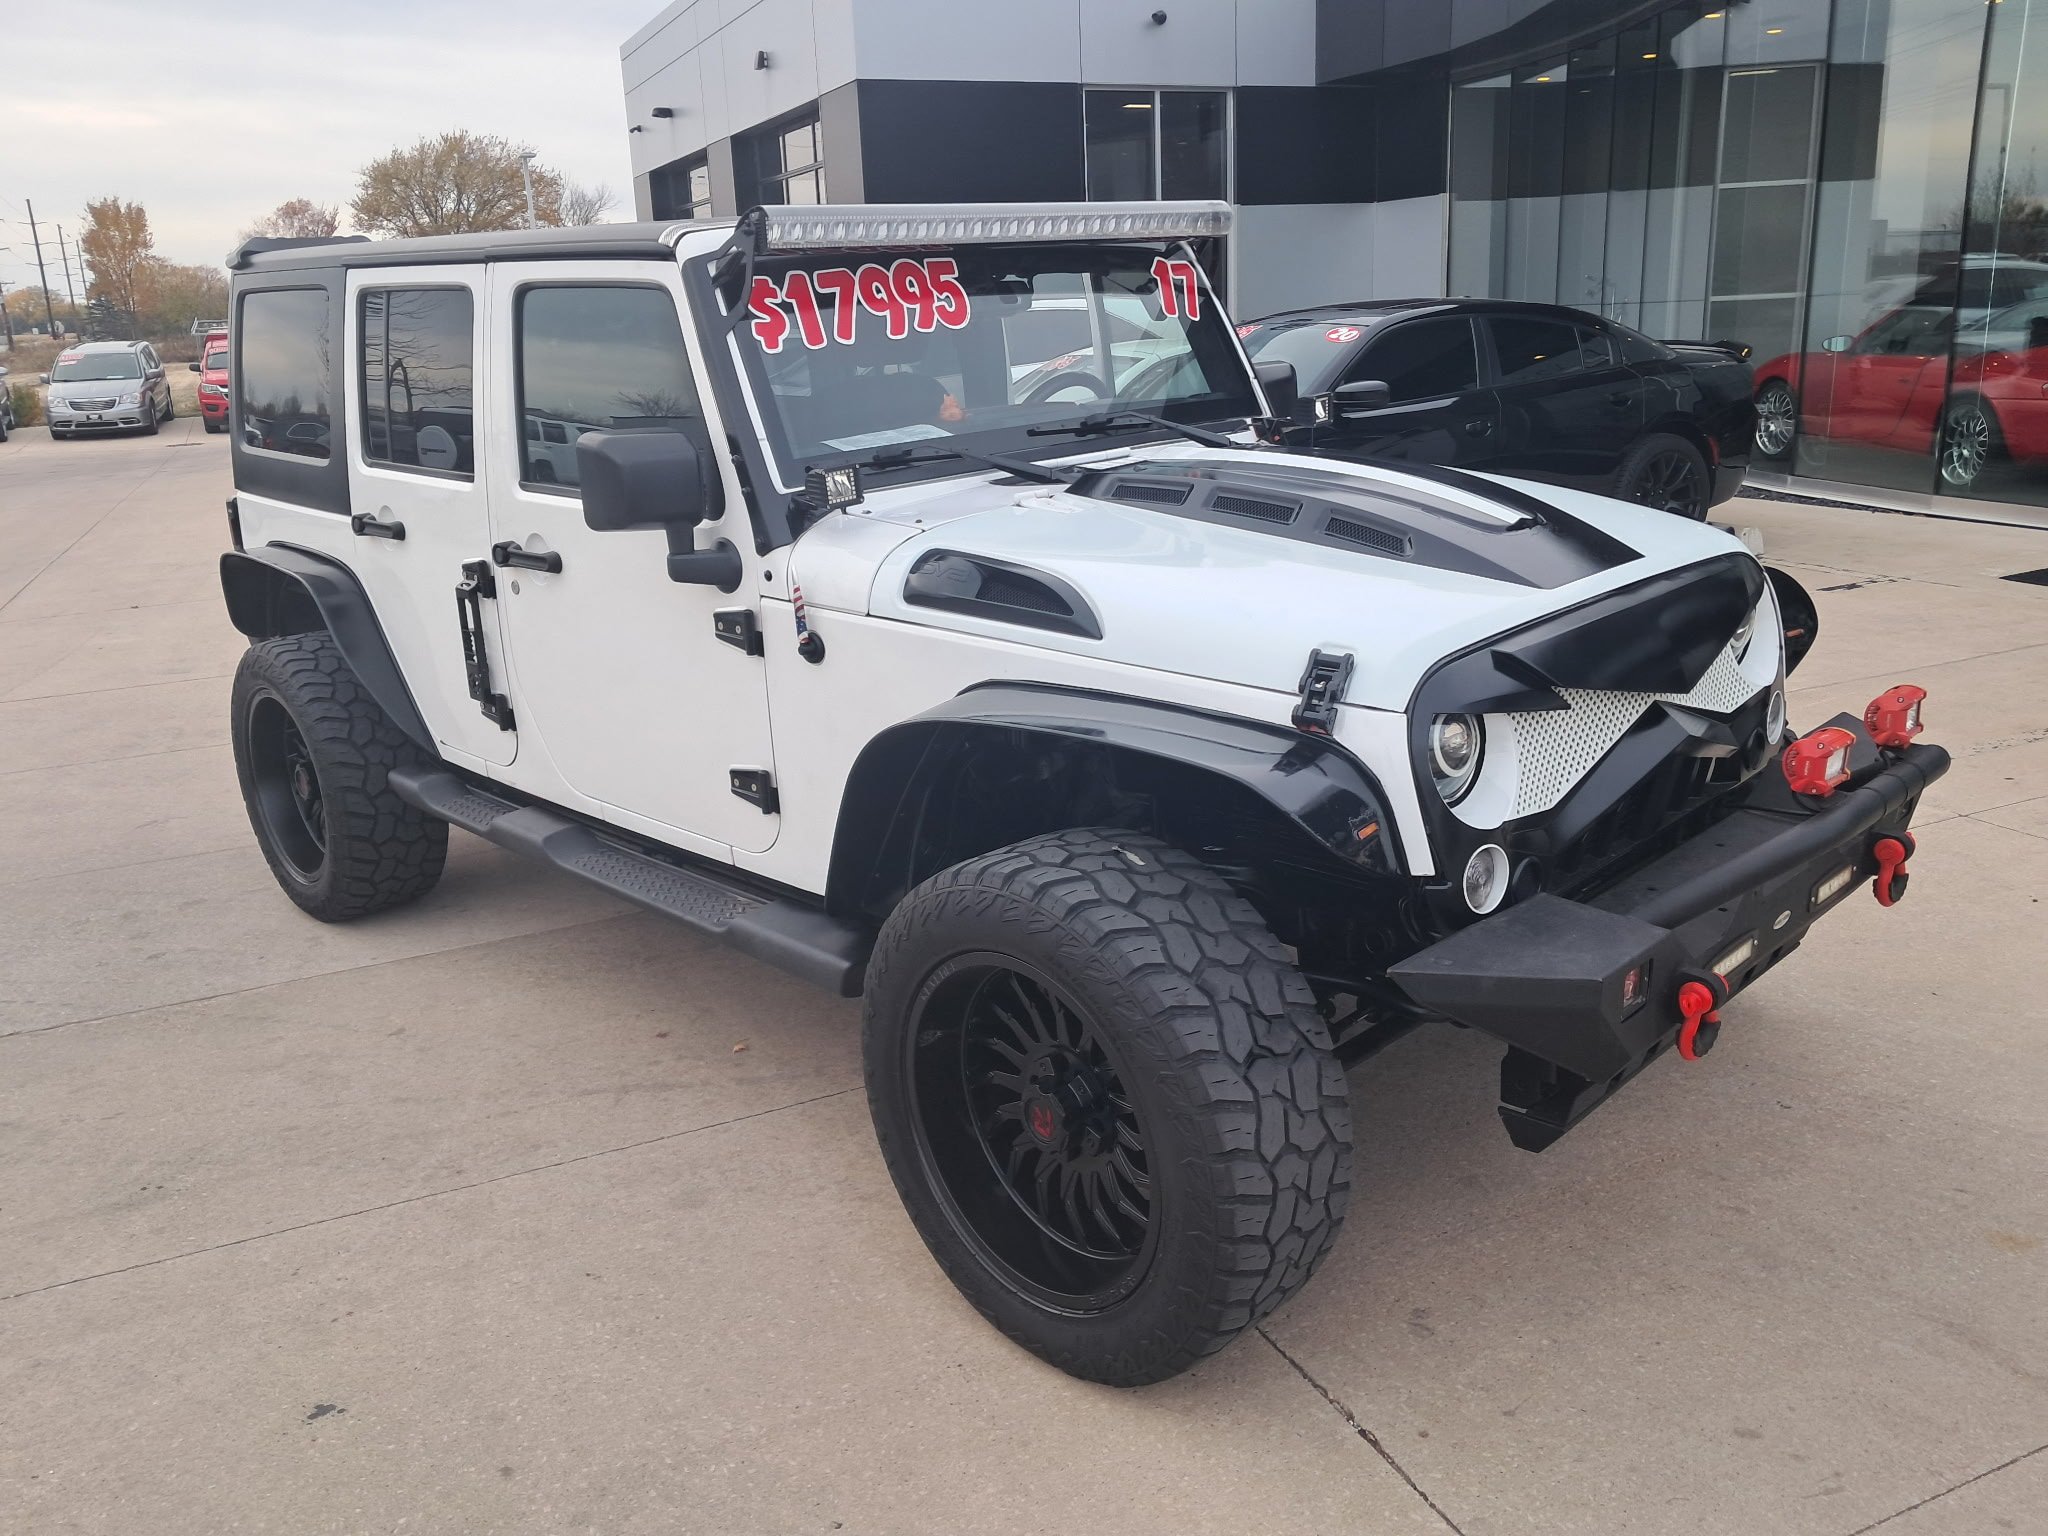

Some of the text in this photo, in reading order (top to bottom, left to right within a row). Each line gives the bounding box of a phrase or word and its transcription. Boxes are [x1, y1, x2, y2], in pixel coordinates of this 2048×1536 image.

[748, 258, 970, 354] $17995
[1150, 256, 1200, 321] 17
[1328, 327, 1359, 342] 20
